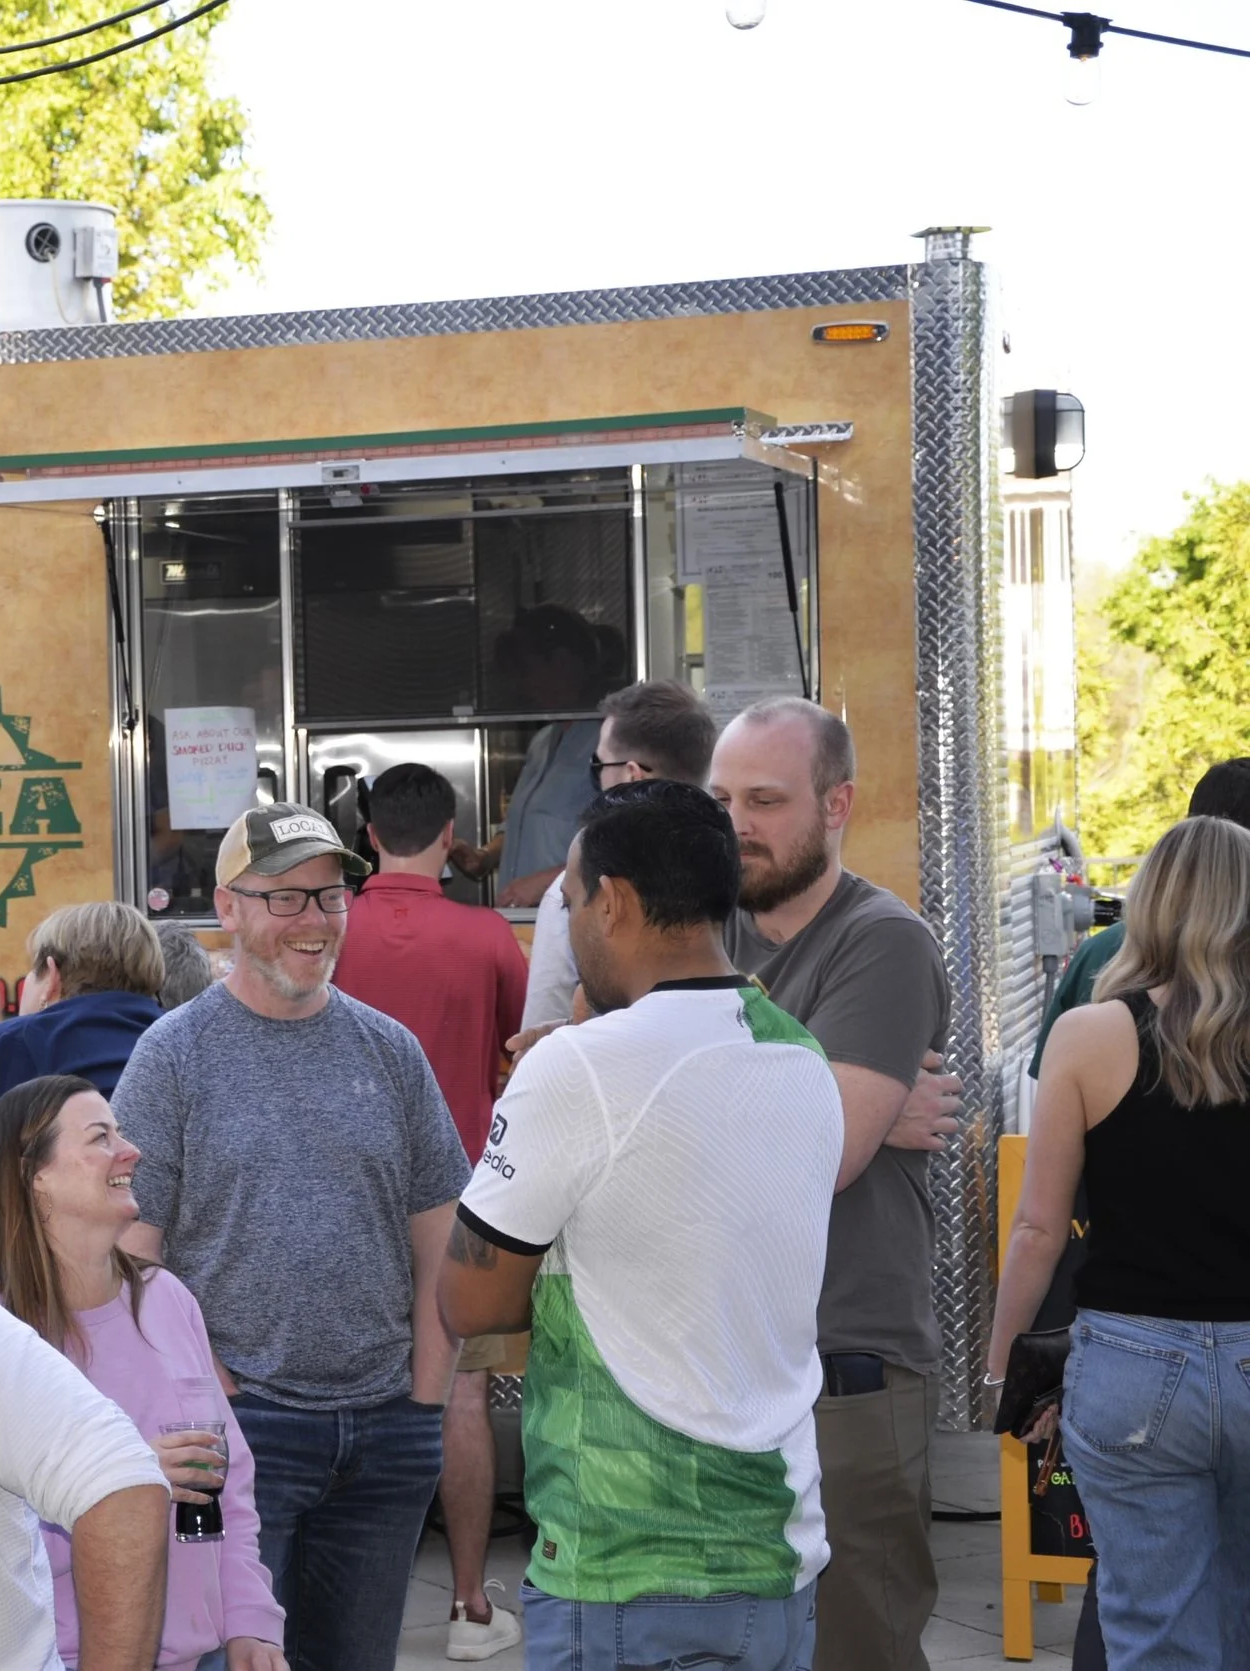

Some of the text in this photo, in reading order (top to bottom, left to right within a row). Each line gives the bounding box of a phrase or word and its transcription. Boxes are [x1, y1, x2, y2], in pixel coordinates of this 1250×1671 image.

[172, 727, 253, 740] ASK ABOUT OUR
[172, 744, 214, 756] SMOKED
[483, 1150, 516, 1180] edia
